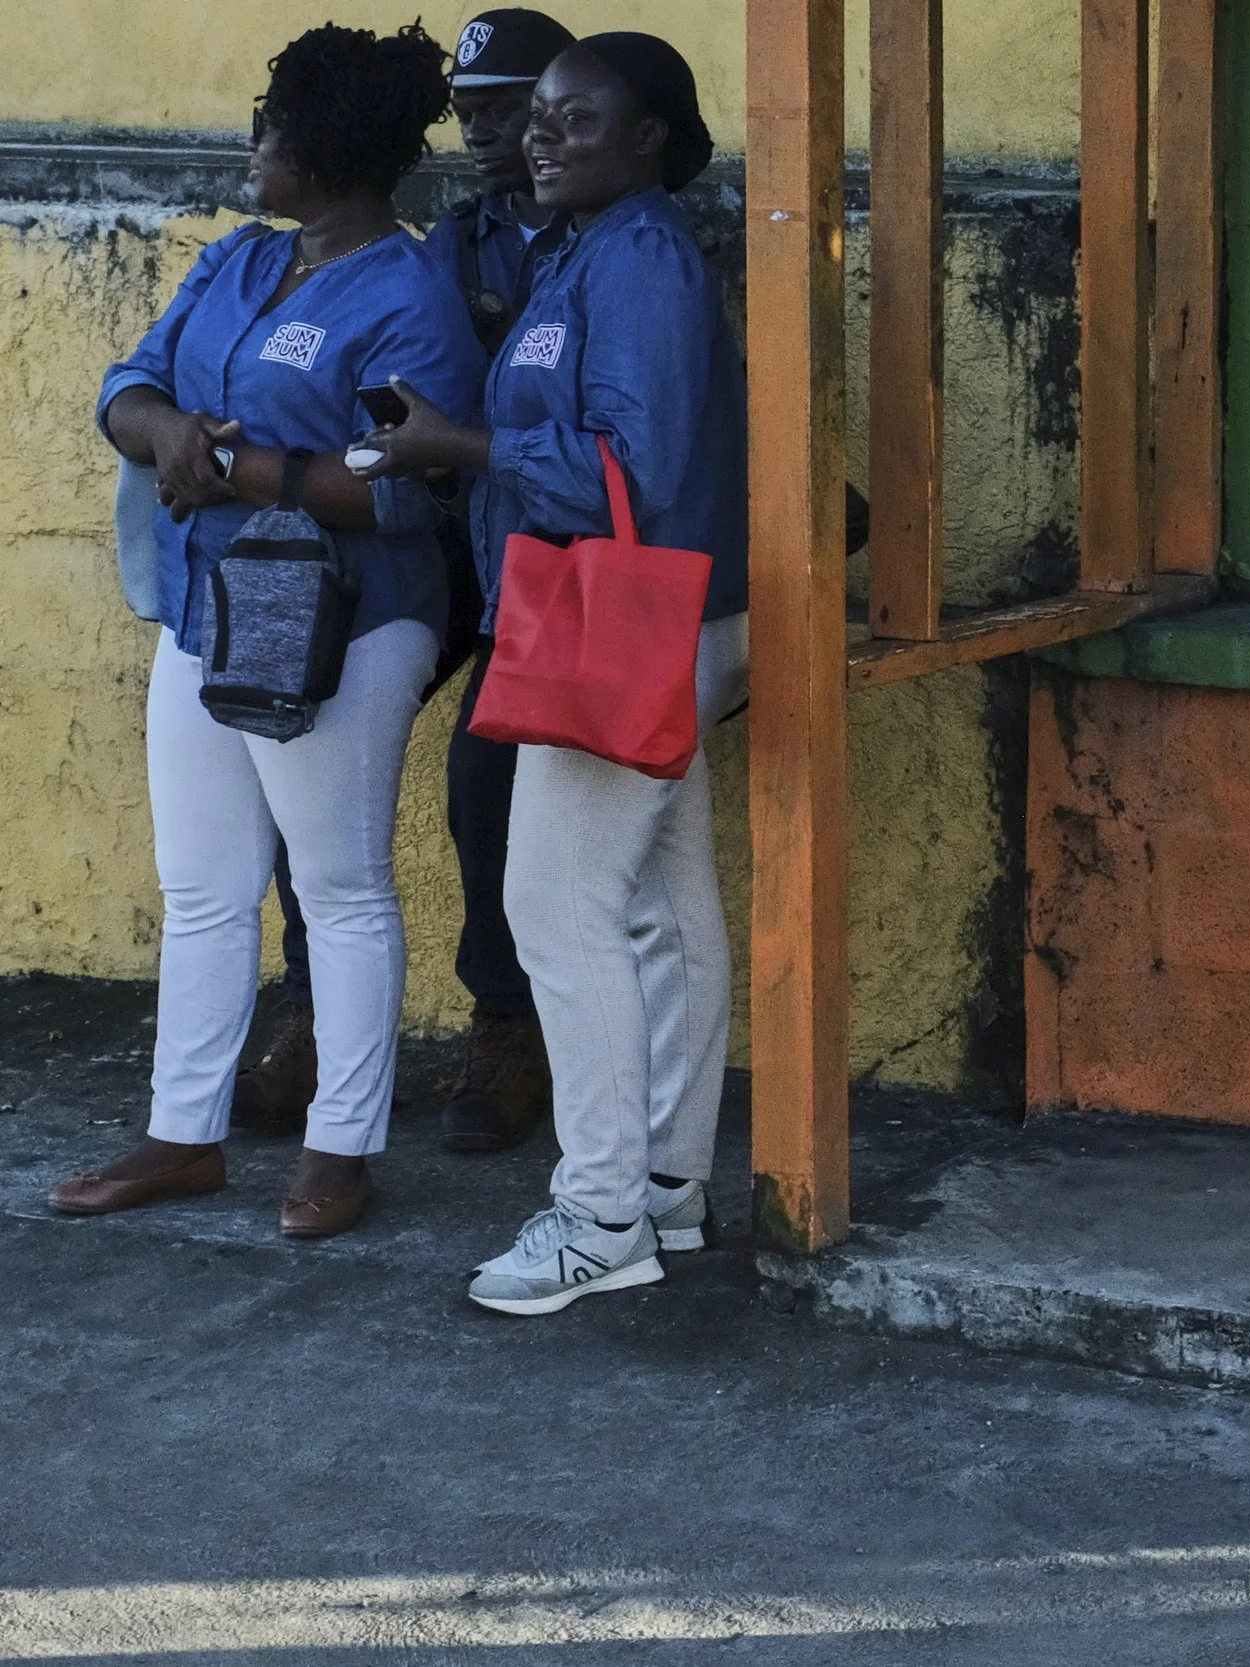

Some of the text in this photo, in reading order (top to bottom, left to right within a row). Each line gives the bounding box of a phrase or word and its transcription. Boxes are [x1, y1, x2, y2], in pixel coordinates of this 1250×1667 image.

[276, 325, 315, 348] SUM
[524, 328, 558, 348] SUM
[264, 340, 308, 362] MUM
[515, 344, 554, 362] MUM
